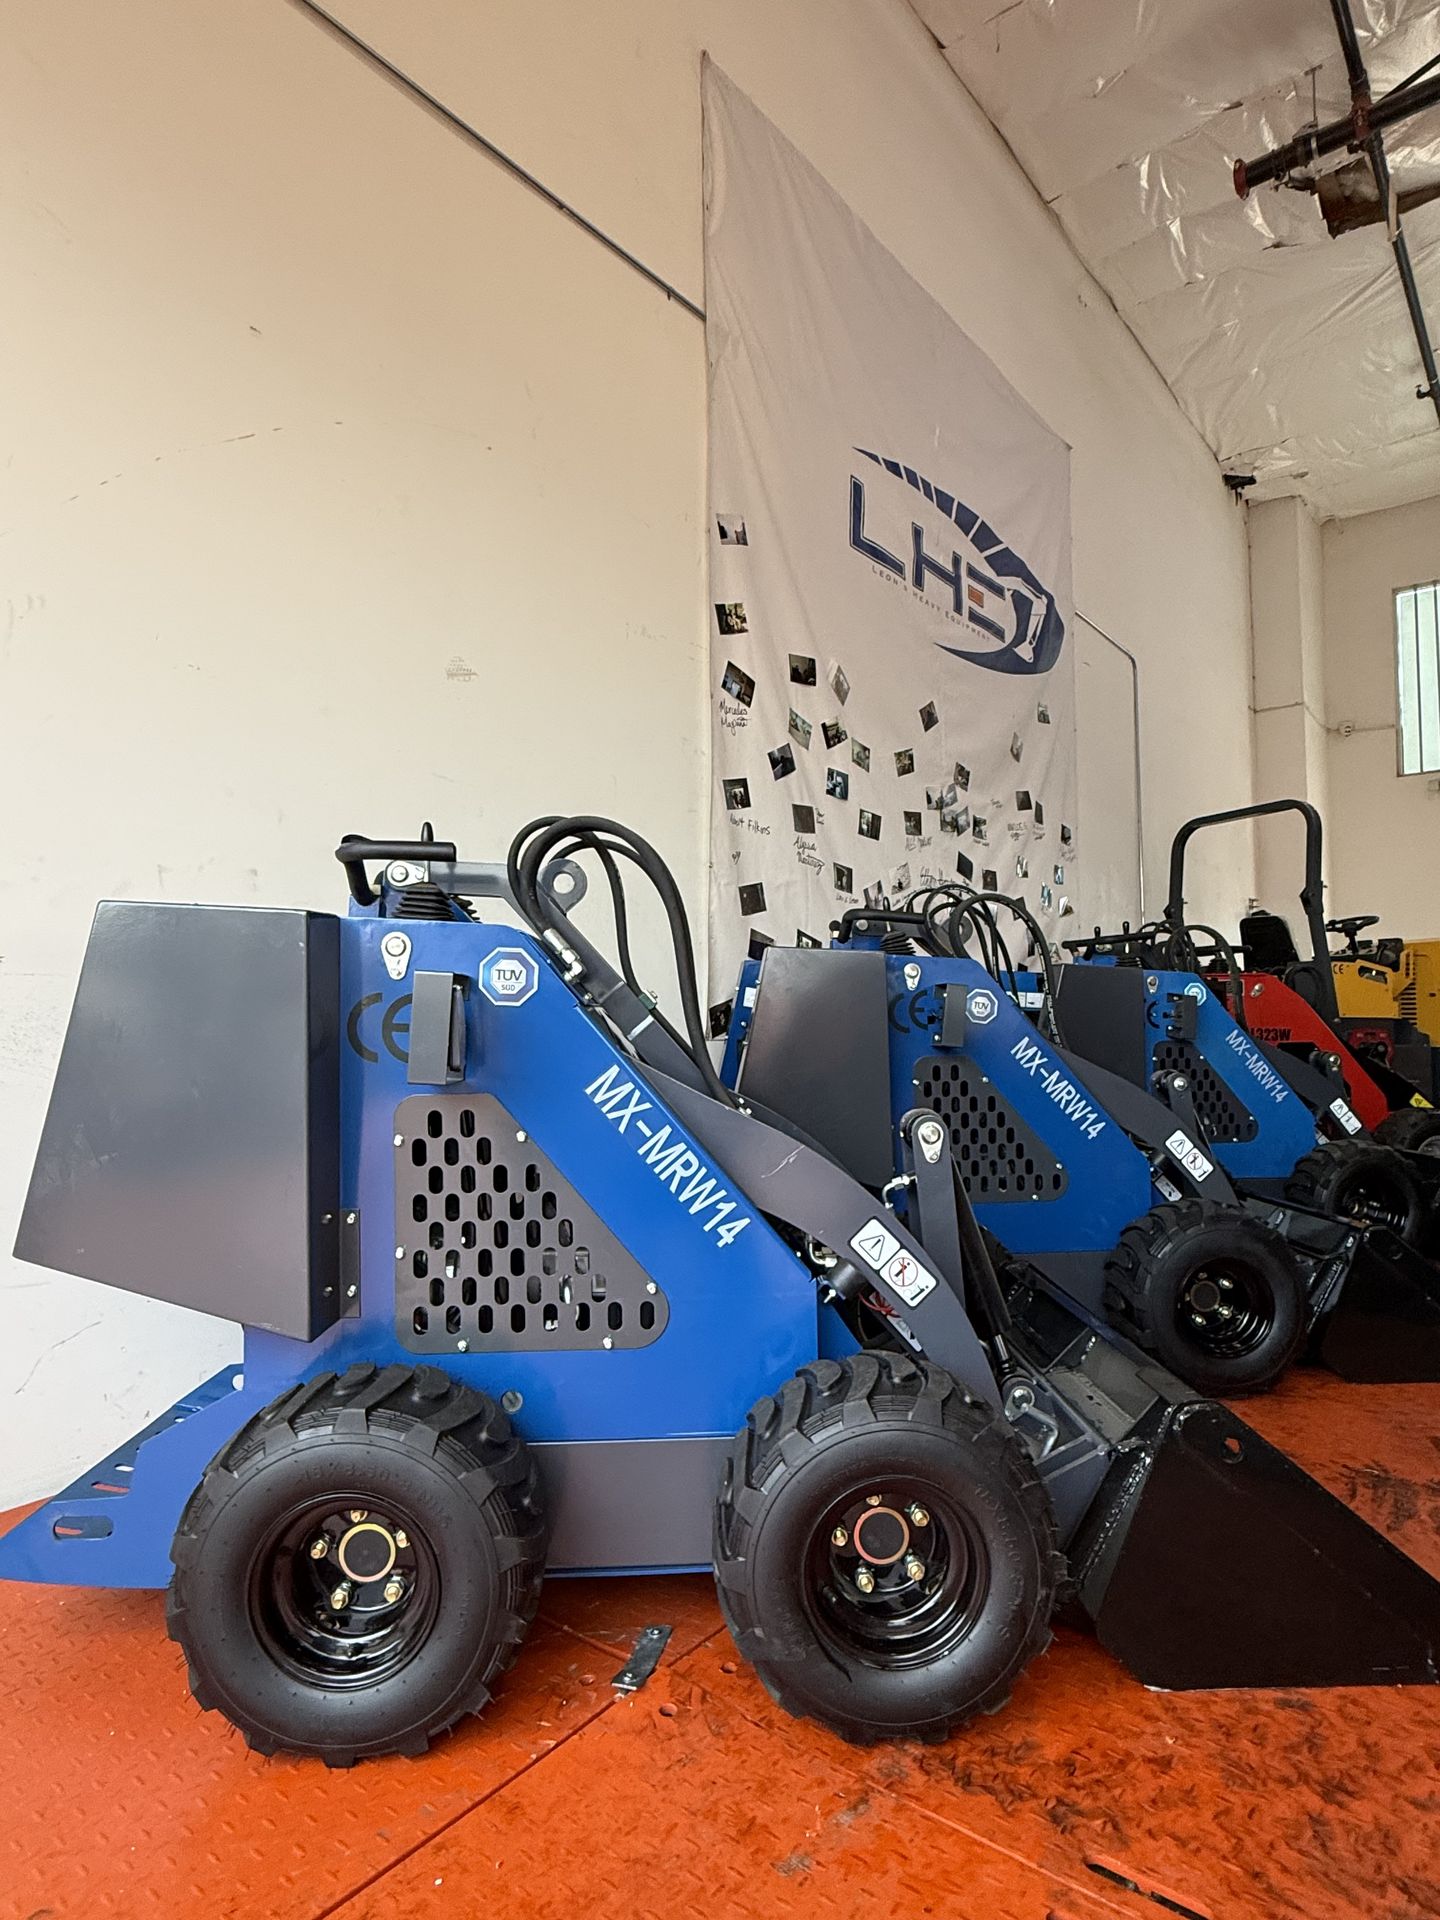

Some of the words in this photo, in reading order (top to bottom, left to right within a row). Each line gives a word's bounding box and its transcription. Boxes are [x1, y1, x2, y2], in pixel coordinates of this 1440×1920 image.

[850, 474, 1006, 644] LHE
[872, 565, 908, 592] LEON'S
[912, 590, 941, 612] HEAVY
[945, 610, 991, 641] EQUIPMENT
[1333, 964, 1343, 974] CE
[347, 992, 414, 1063] CE
[888, 989, 928, 1034] CE
[1010, 1036, 1106, 1139] MX-MRW14
[1225, 1029, 1289, 1103] MX-MRW14
[584, 1064, 751, 1248] MX-MRW14
